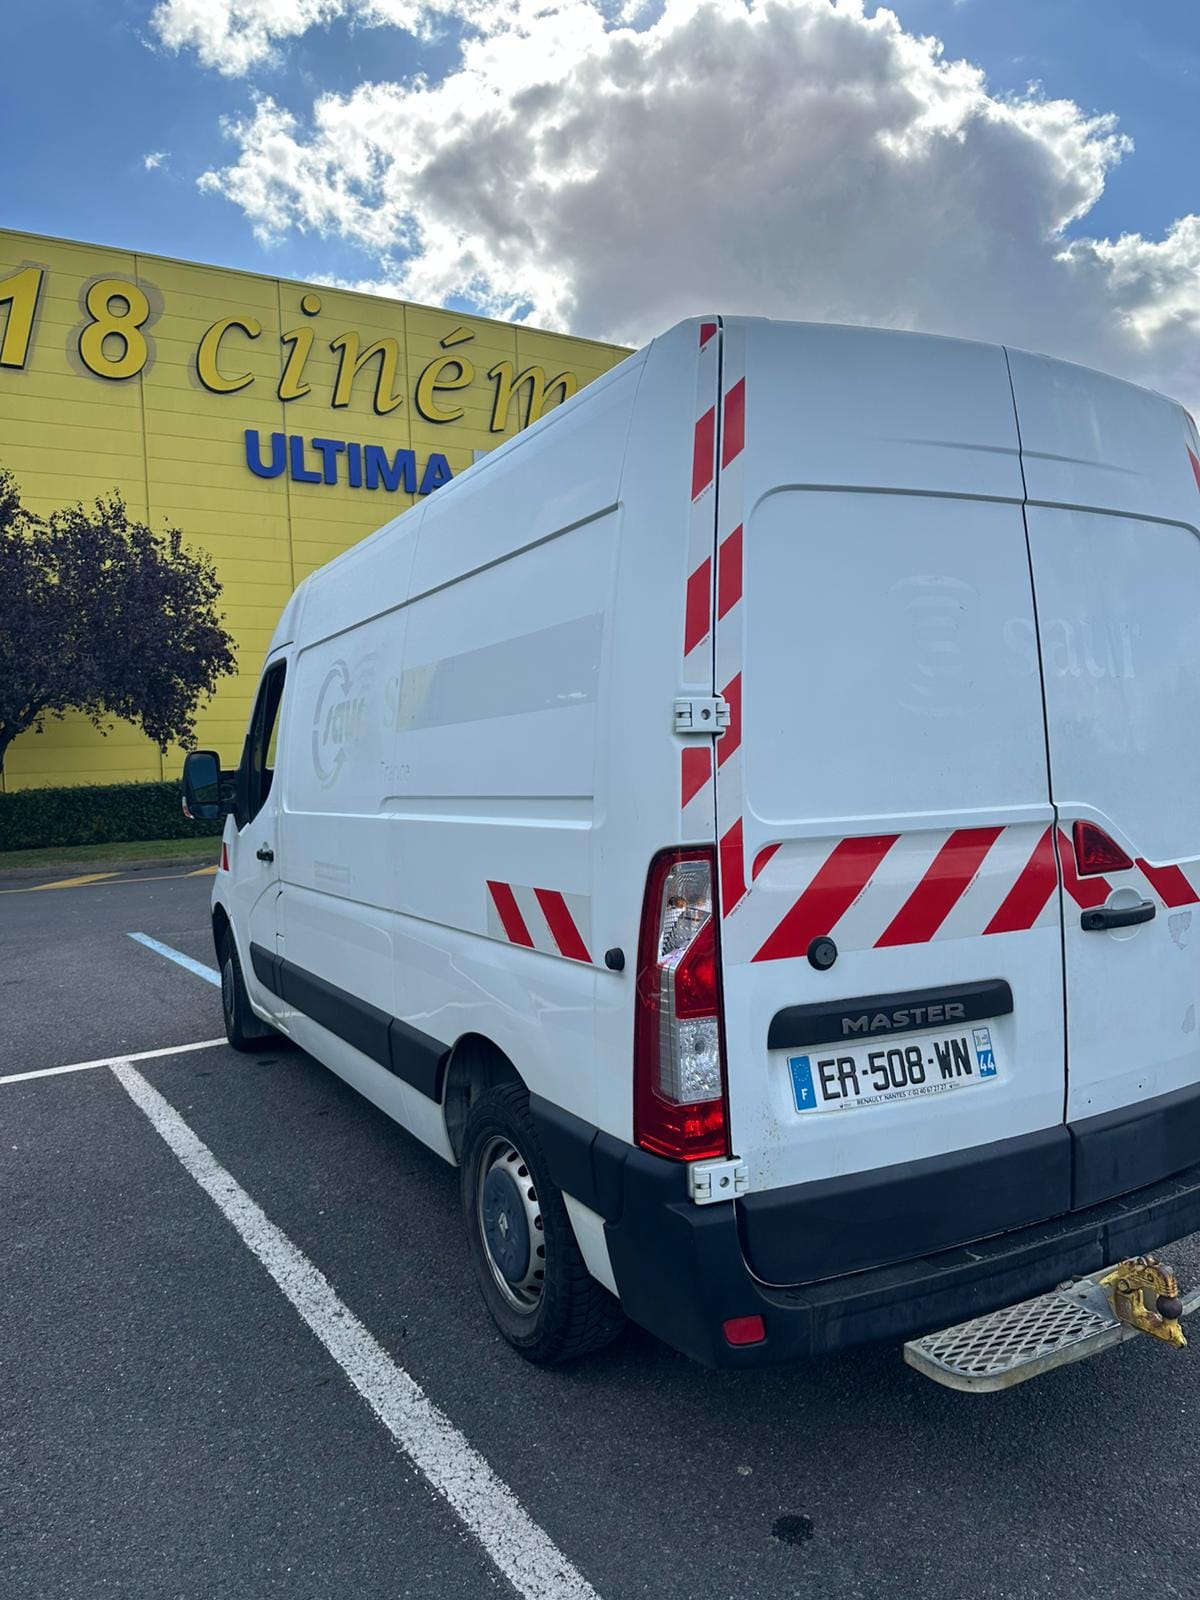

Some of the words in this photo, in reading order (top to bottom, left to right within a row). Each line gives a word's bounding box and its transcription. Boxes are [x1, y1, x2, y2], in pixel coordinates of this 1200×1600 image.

[0, 266, 150, 379] 18
[841, 1003, 967, 1035] MASTER
[817, 1037, 973, 1101] ER-508-WN
[980, 1053, 995, 1072] 44
[801, 1088, 808, 1100] F
[856, 1095, 883, 1105] RENAULT
[884, 1091, 906, 1101] NANTES
